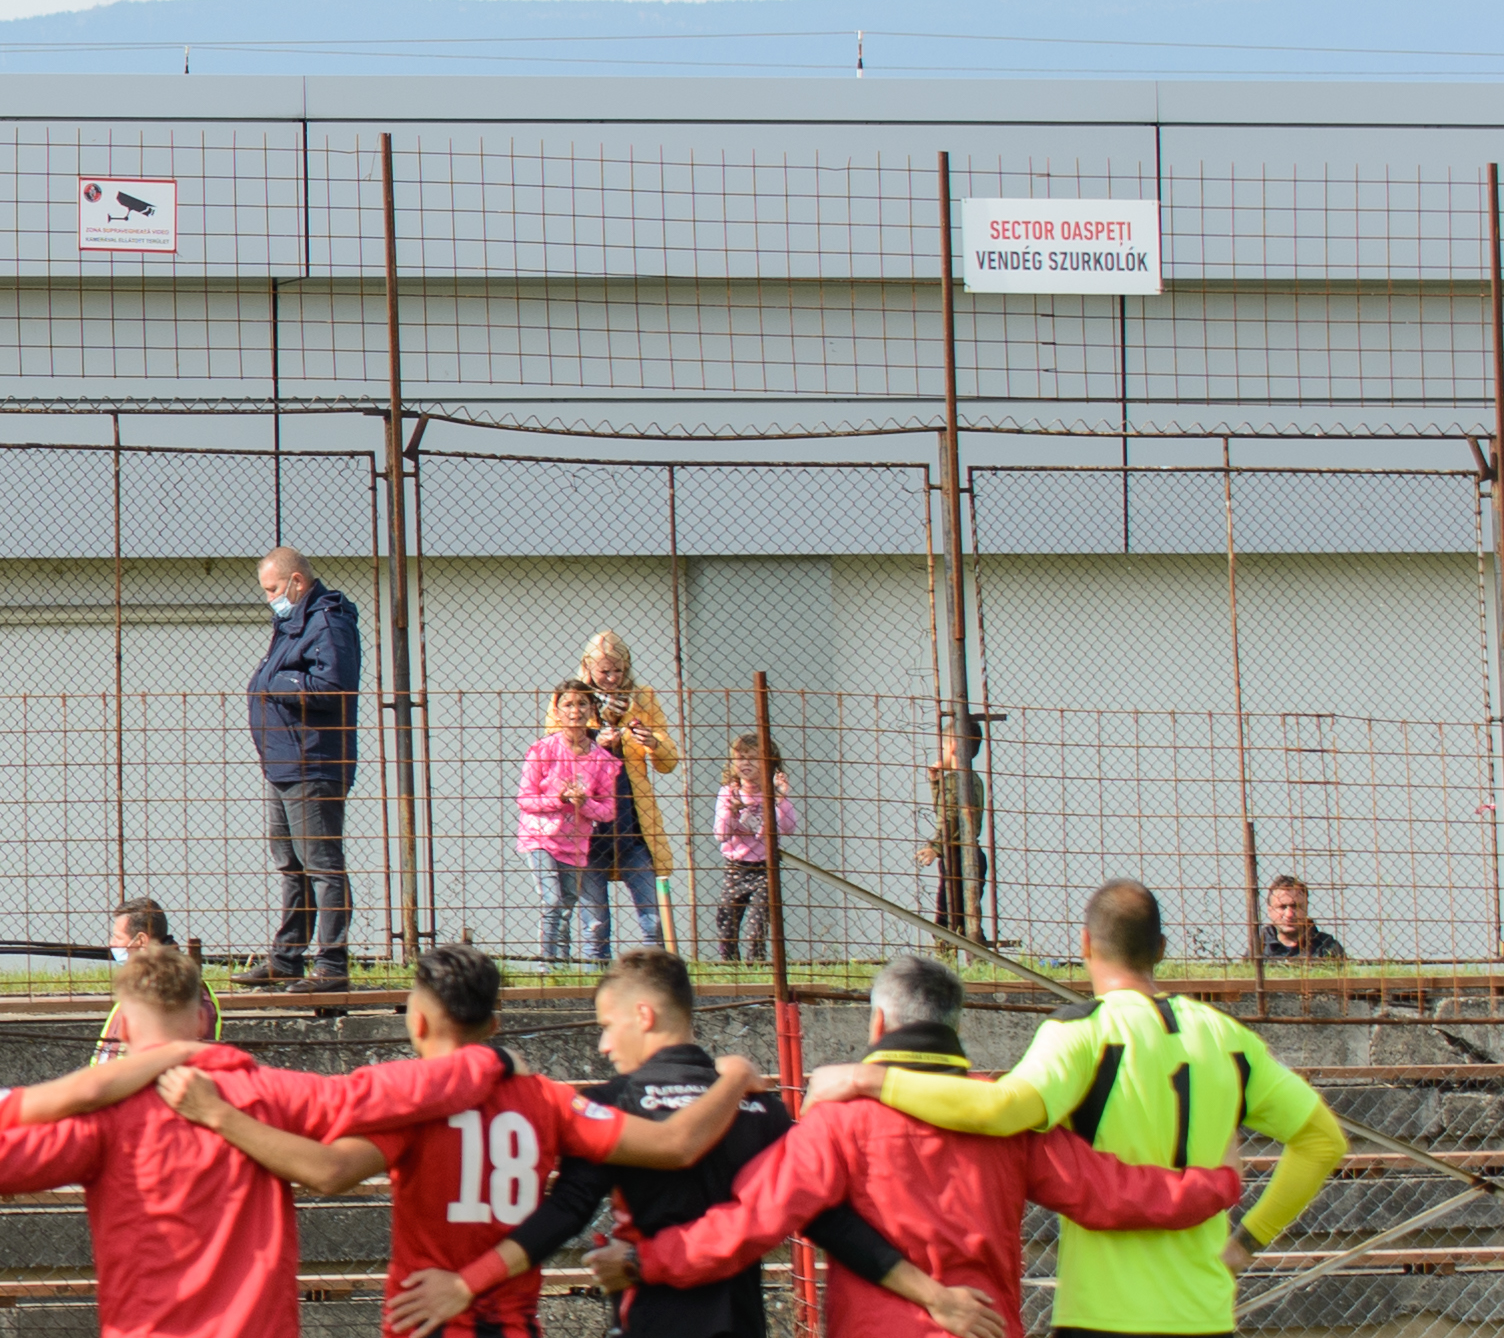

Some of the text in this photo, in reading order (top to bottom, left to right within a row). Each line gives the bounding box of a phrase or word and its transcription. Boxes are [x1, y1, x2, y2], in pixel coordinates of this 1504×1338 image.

[975, 245, 1148, 272] VENDÉG SZURKOLÓK
[989, 220, 1132, 247] SECTOR OASPEȚI
[1169, 1061, 1190, 1169] 1
[447, 1110, 539, 1225] 18
